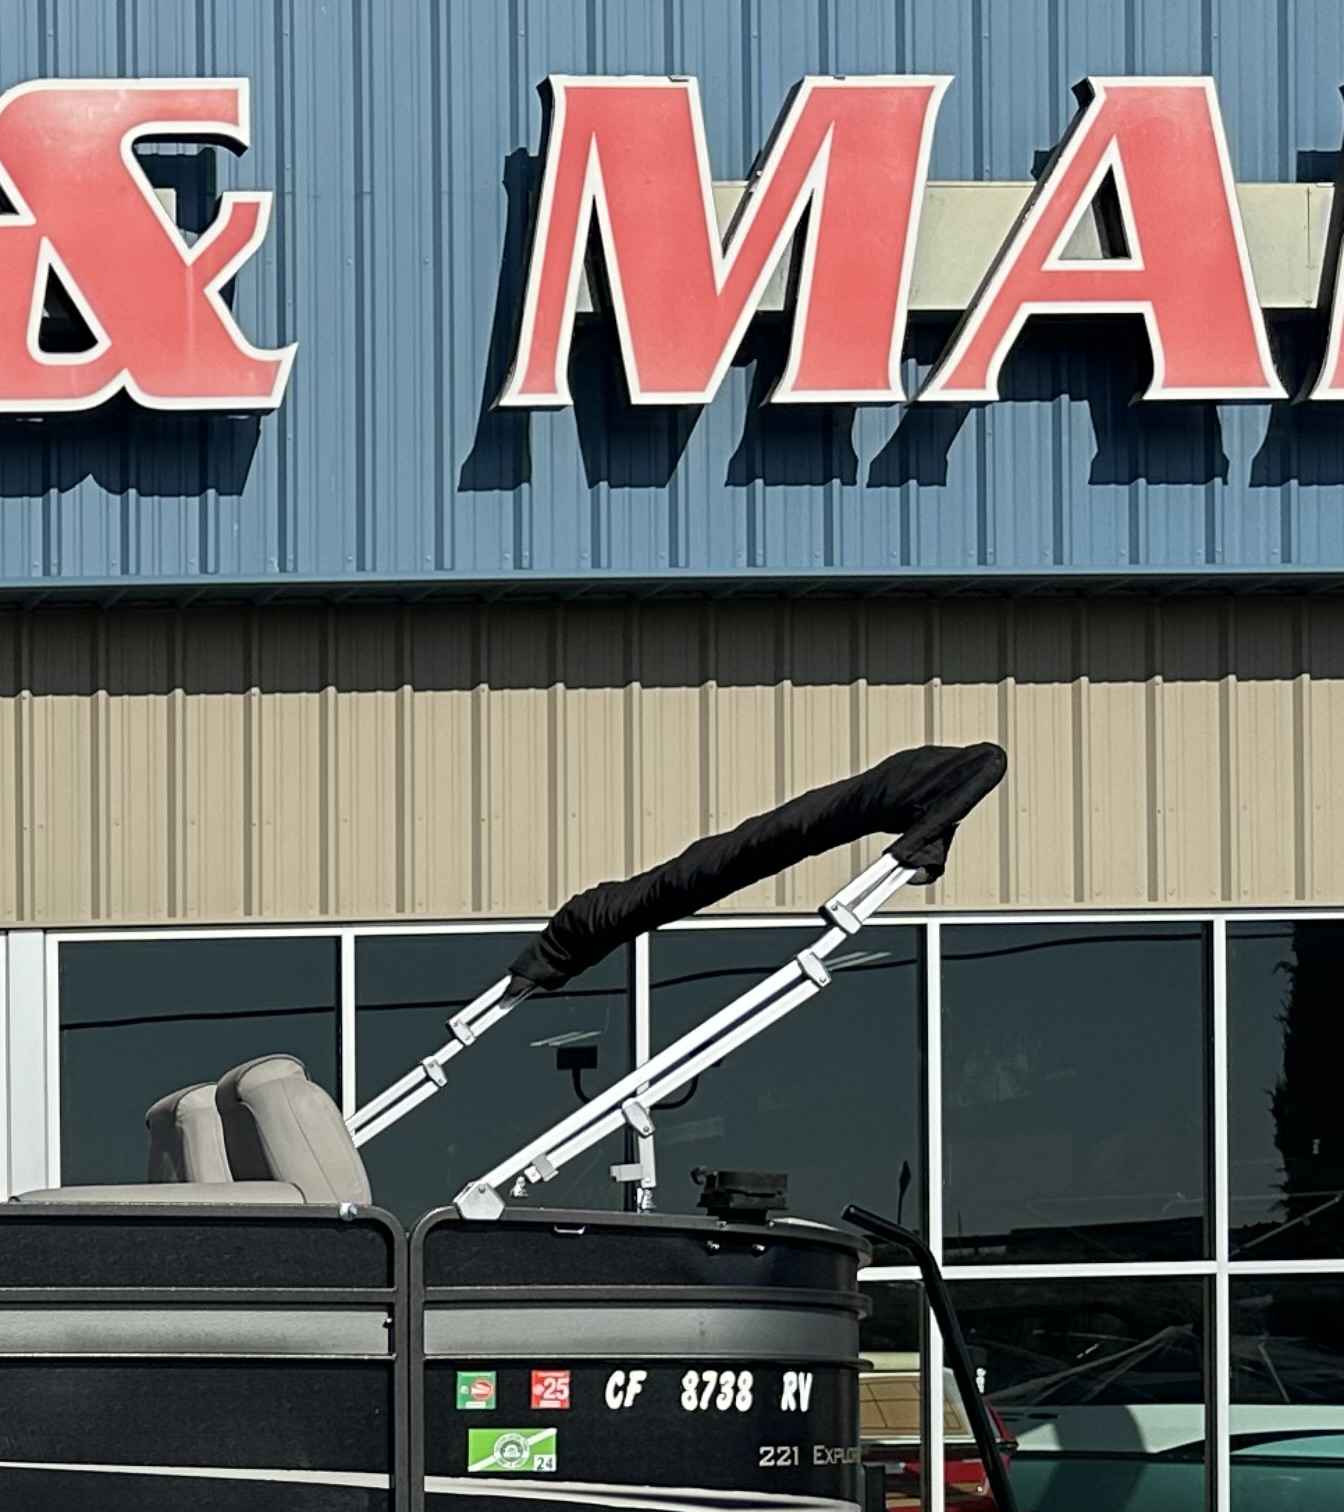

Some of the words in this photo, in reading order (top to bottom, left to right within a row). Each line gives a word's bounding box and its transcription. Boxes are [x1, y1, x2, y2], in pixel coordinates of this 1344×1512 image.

[498, 74, 1344, 404] MA
[543, 1377, 570, 1400] 25
[605, 1370, 648, 1410] CF
[680, 1370, 754, 1412] 8738
[781, 1371, 812, 1412] RV
[536, 1456, 554, 1471] 24
[759, 1446, 800, 1467] 221
